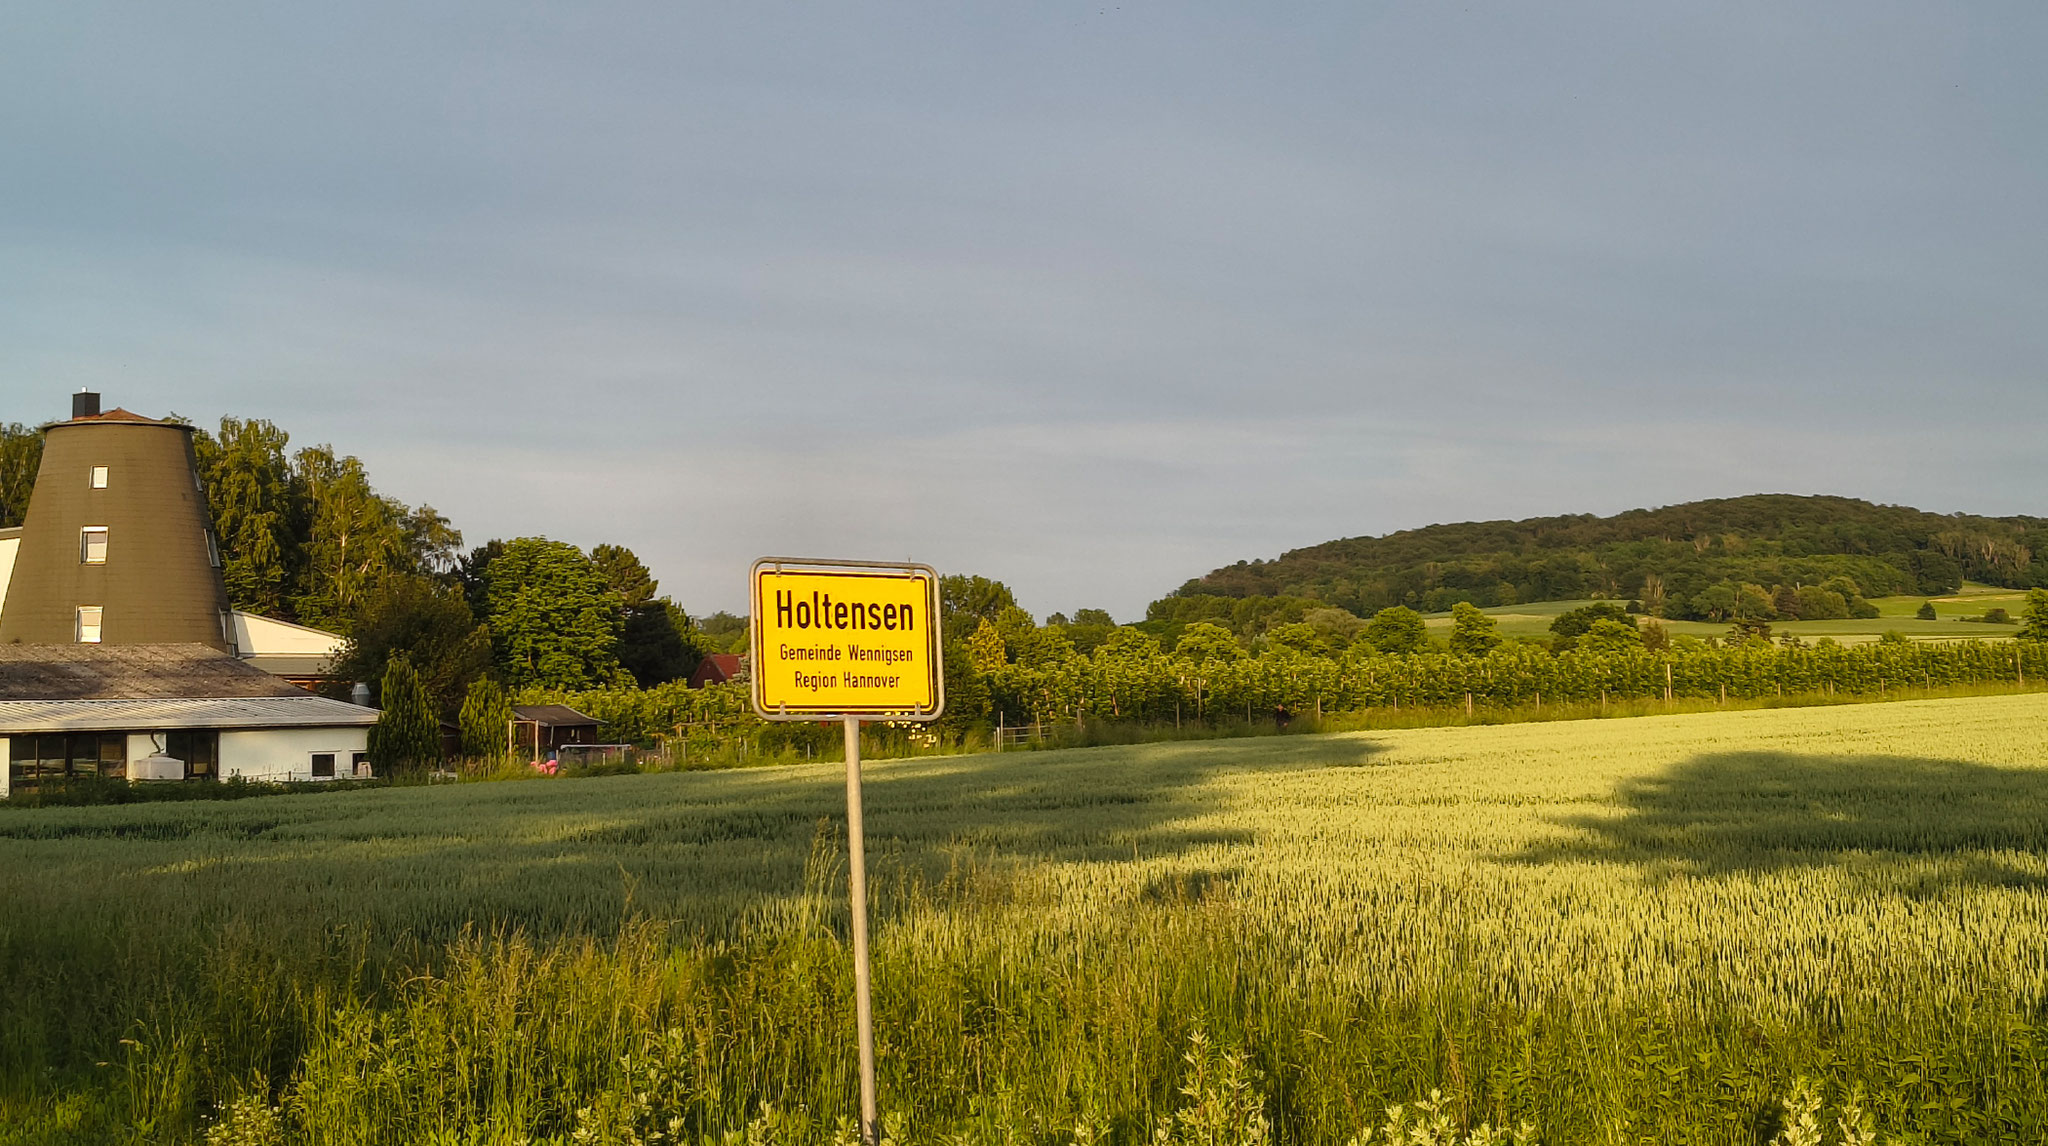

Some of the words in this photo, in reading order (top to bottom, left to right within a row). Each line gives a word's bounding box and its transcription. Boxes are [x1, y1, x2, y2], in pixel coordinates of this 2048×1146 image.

[776, 589, 914, 631] Holtensen
[780, 643, 841, 661] Gemeinde
[848, 644, 913, 666] Wennigsen
[795, 670, 837, 692] Region
[843, 671, 900, 688] Hannover
